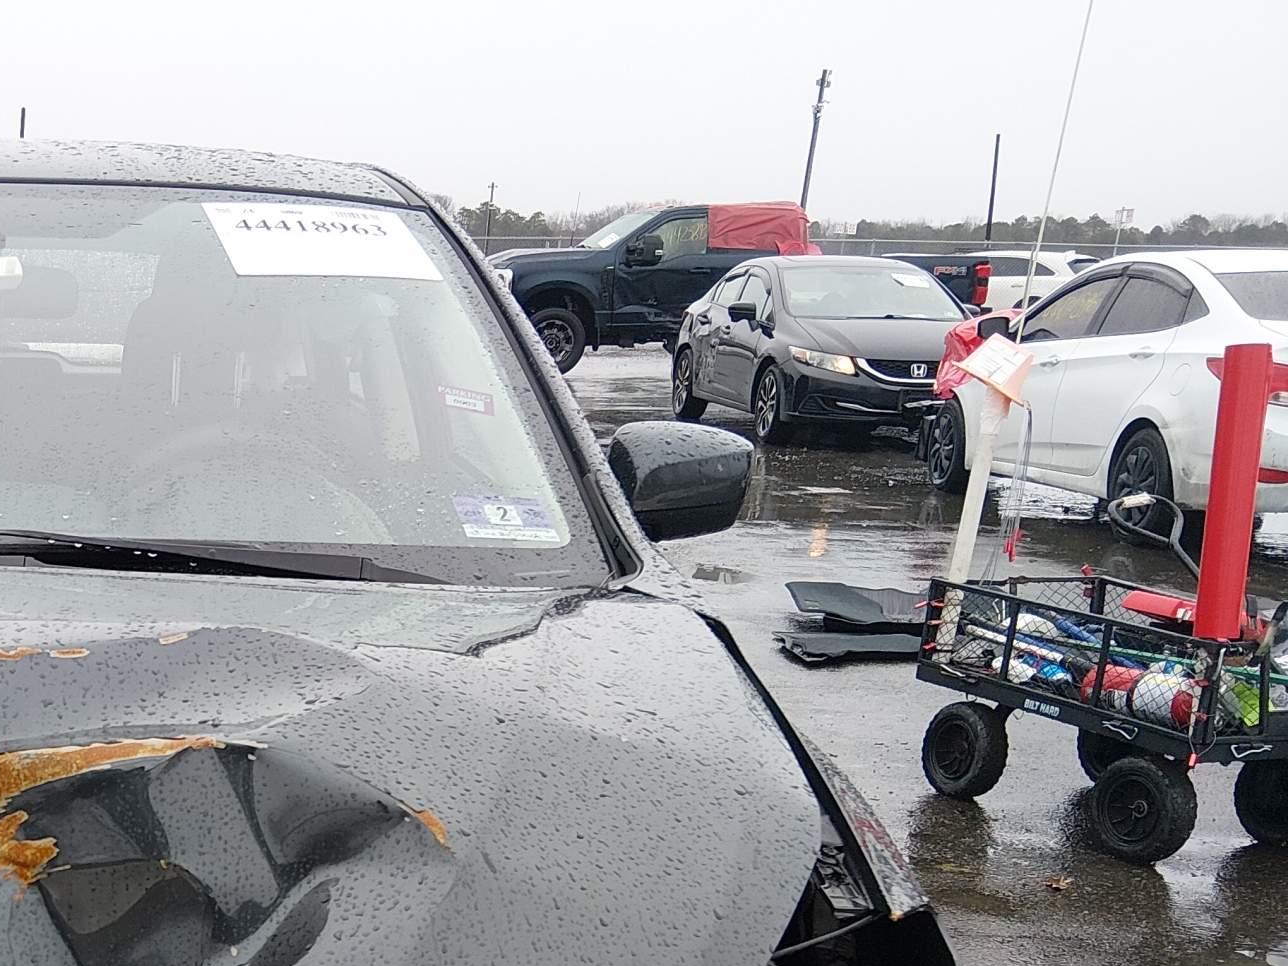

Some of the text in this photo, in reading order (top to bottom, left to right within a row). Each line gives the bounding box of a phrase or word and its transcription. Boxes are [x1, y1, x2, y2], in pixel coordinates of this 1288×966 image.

[234, 218, 388, 236] 44418963
[933, 265, 969, 276] FX4
[438, 386, 491, 401] PARKING
[495, 506, 512, 522] 2
[1024, 699, 1059, 716] BILT HARD
